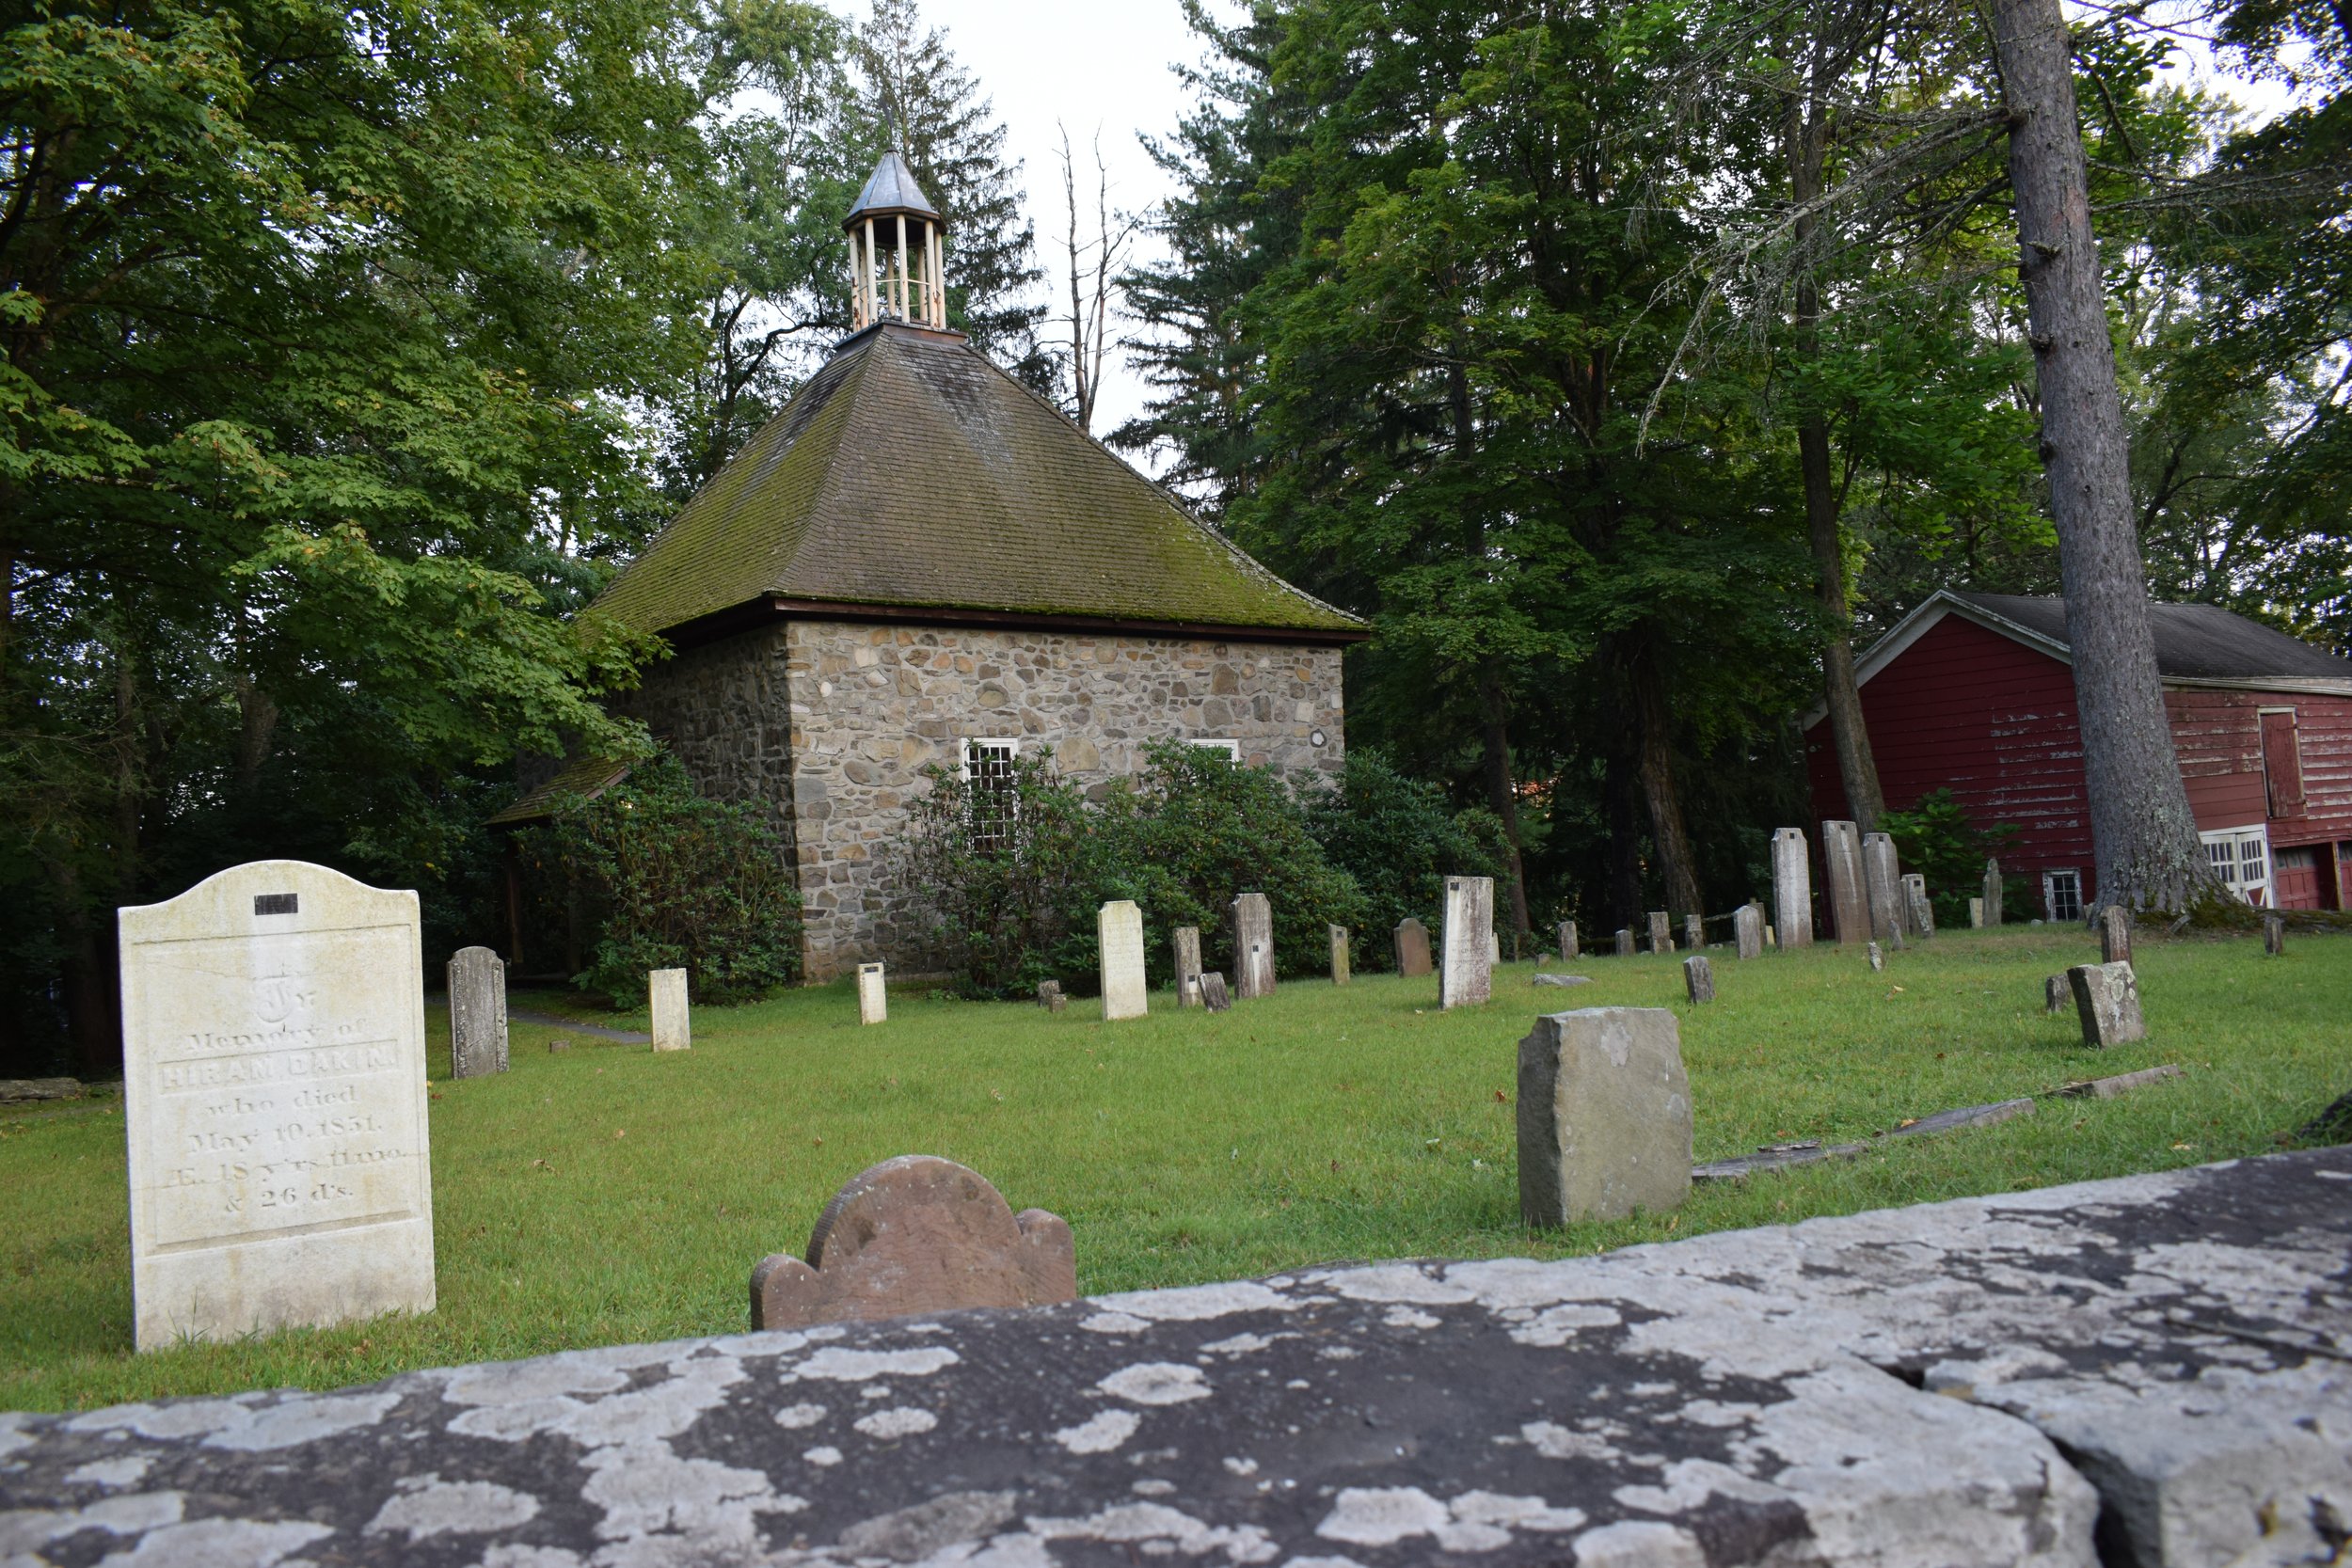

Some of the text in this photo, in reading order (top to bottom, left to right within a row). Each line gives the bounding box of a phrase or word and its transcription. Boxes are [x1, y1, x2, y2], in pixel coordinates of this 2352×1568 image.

[186, 1018, 368, 1053] Memory of
[161, 1056, 276, 1089] HIRAM
[205, 1085, 359, 1117] who died
[186, 1128, 260, 1154] May
[224, 1195, 244, 1214] &
[260, 1186, 297, 1209] 26
